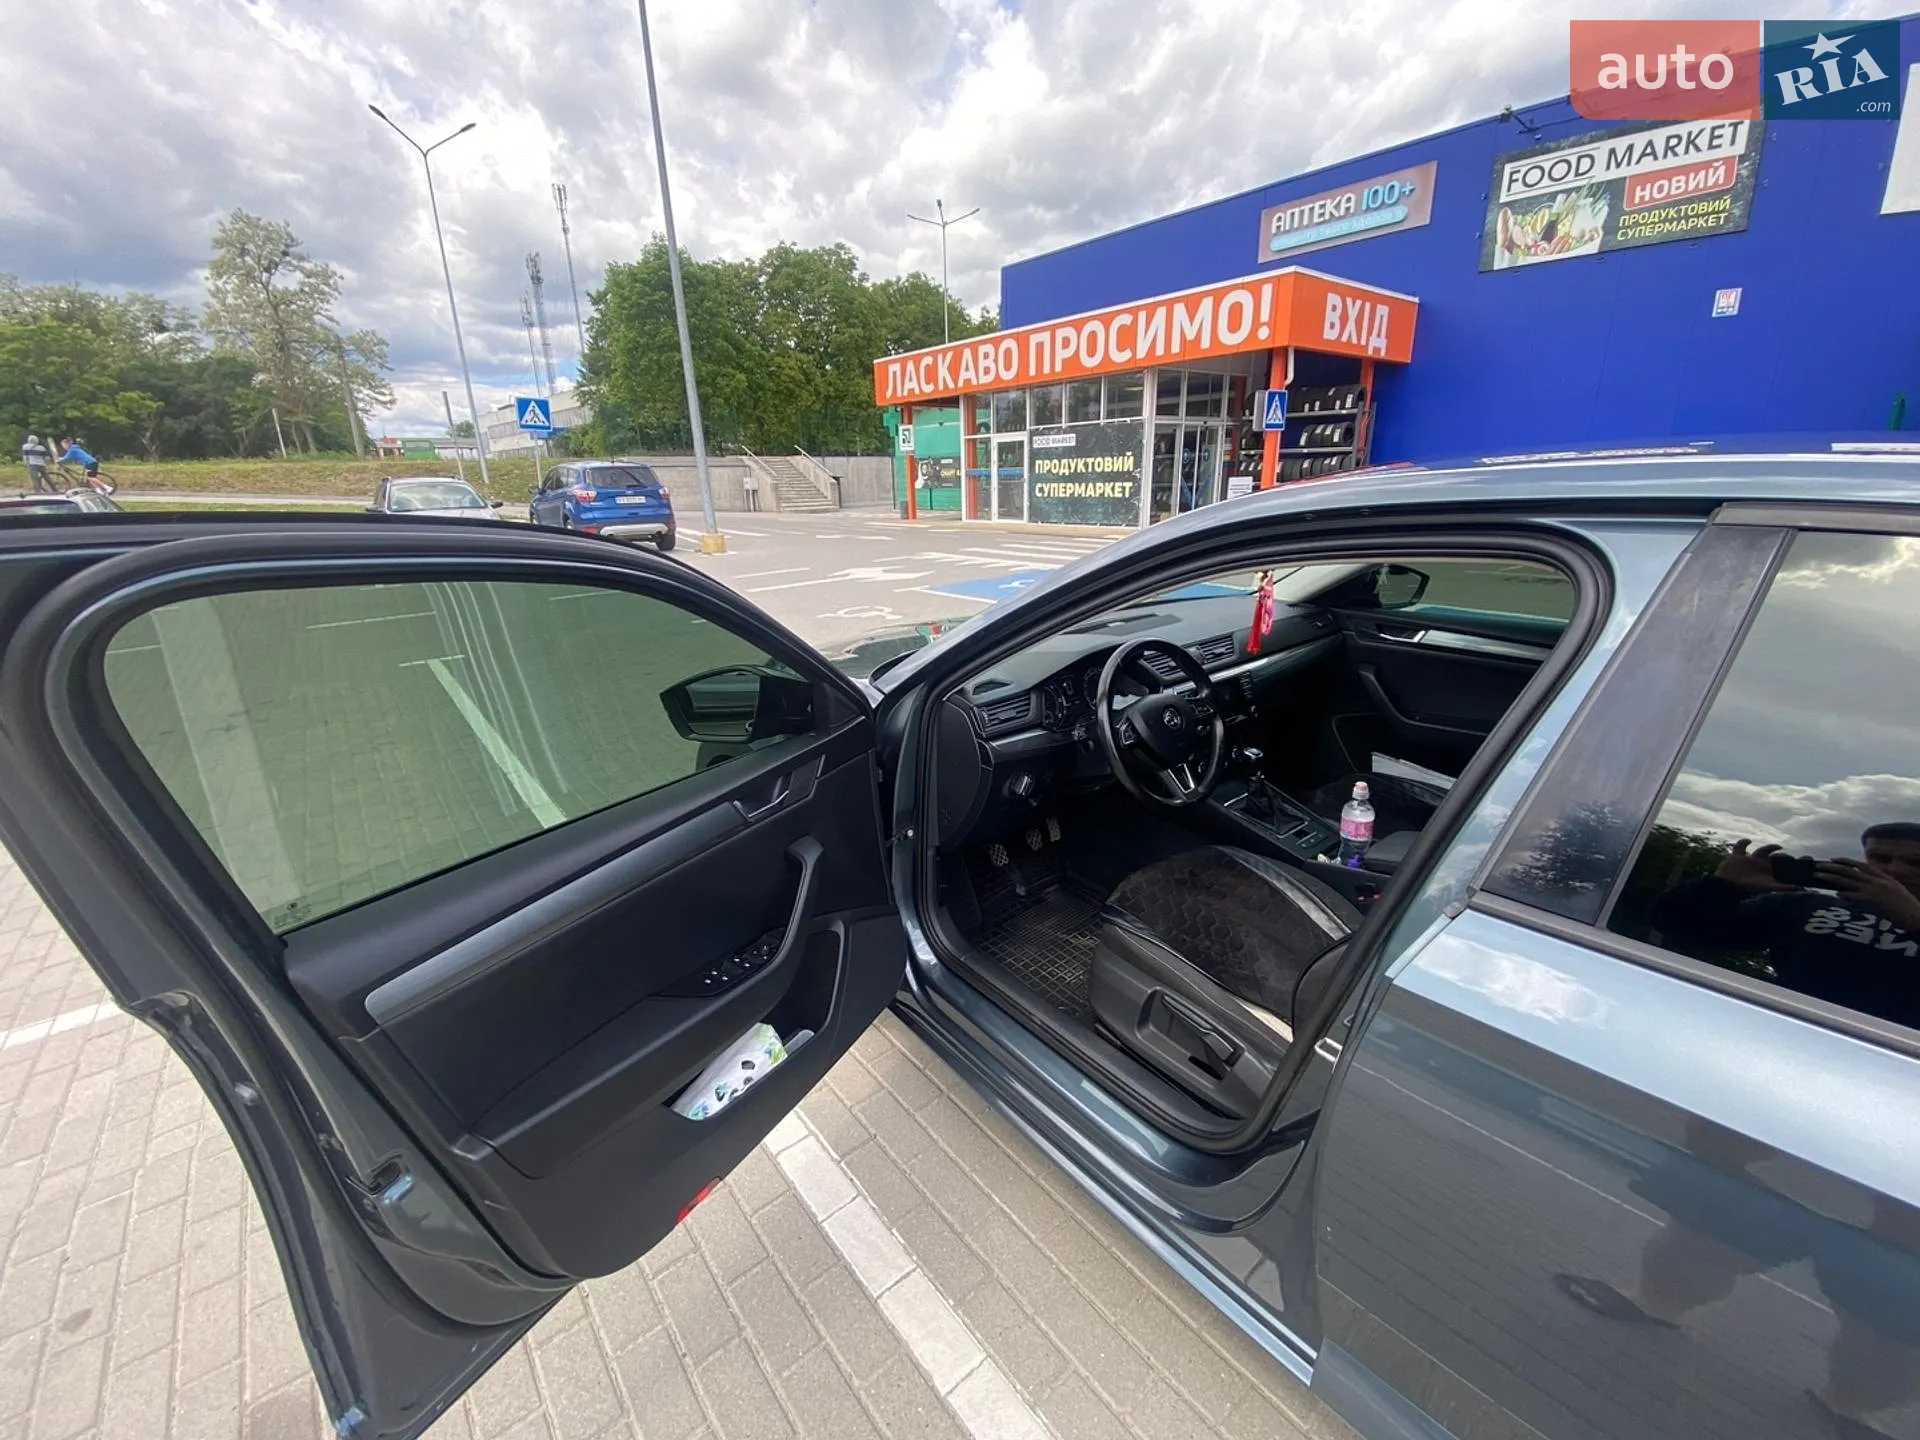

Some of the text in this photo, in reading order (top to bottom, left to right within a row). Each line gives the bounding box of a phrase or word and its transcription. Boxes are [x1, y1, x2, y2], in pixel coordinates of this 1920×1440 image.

[1506, 120, 1745, 193] FOOD MARKET
[1633, 161, 1726, 204] НОВИЙ
[1271, 192, 1356, 235] АПТЕКА
[1361, 180, 1416, 211] 100+
[1616, 212, 1729, 241] СУПЕРМАРКЕТ
[1618, 195, 1732, 228] ПРОДУКТОВИЙ
[885, 282, 1274, 400] ЛАСКАВО ПРОСИМО!
[1321, 291, 1390, 358] ВХІД
[1035, 451, 1135, 476] ПРОДУКТОВИЙ
[1035, 481, 1134, 498] СУПЕРМАРКЕТ
